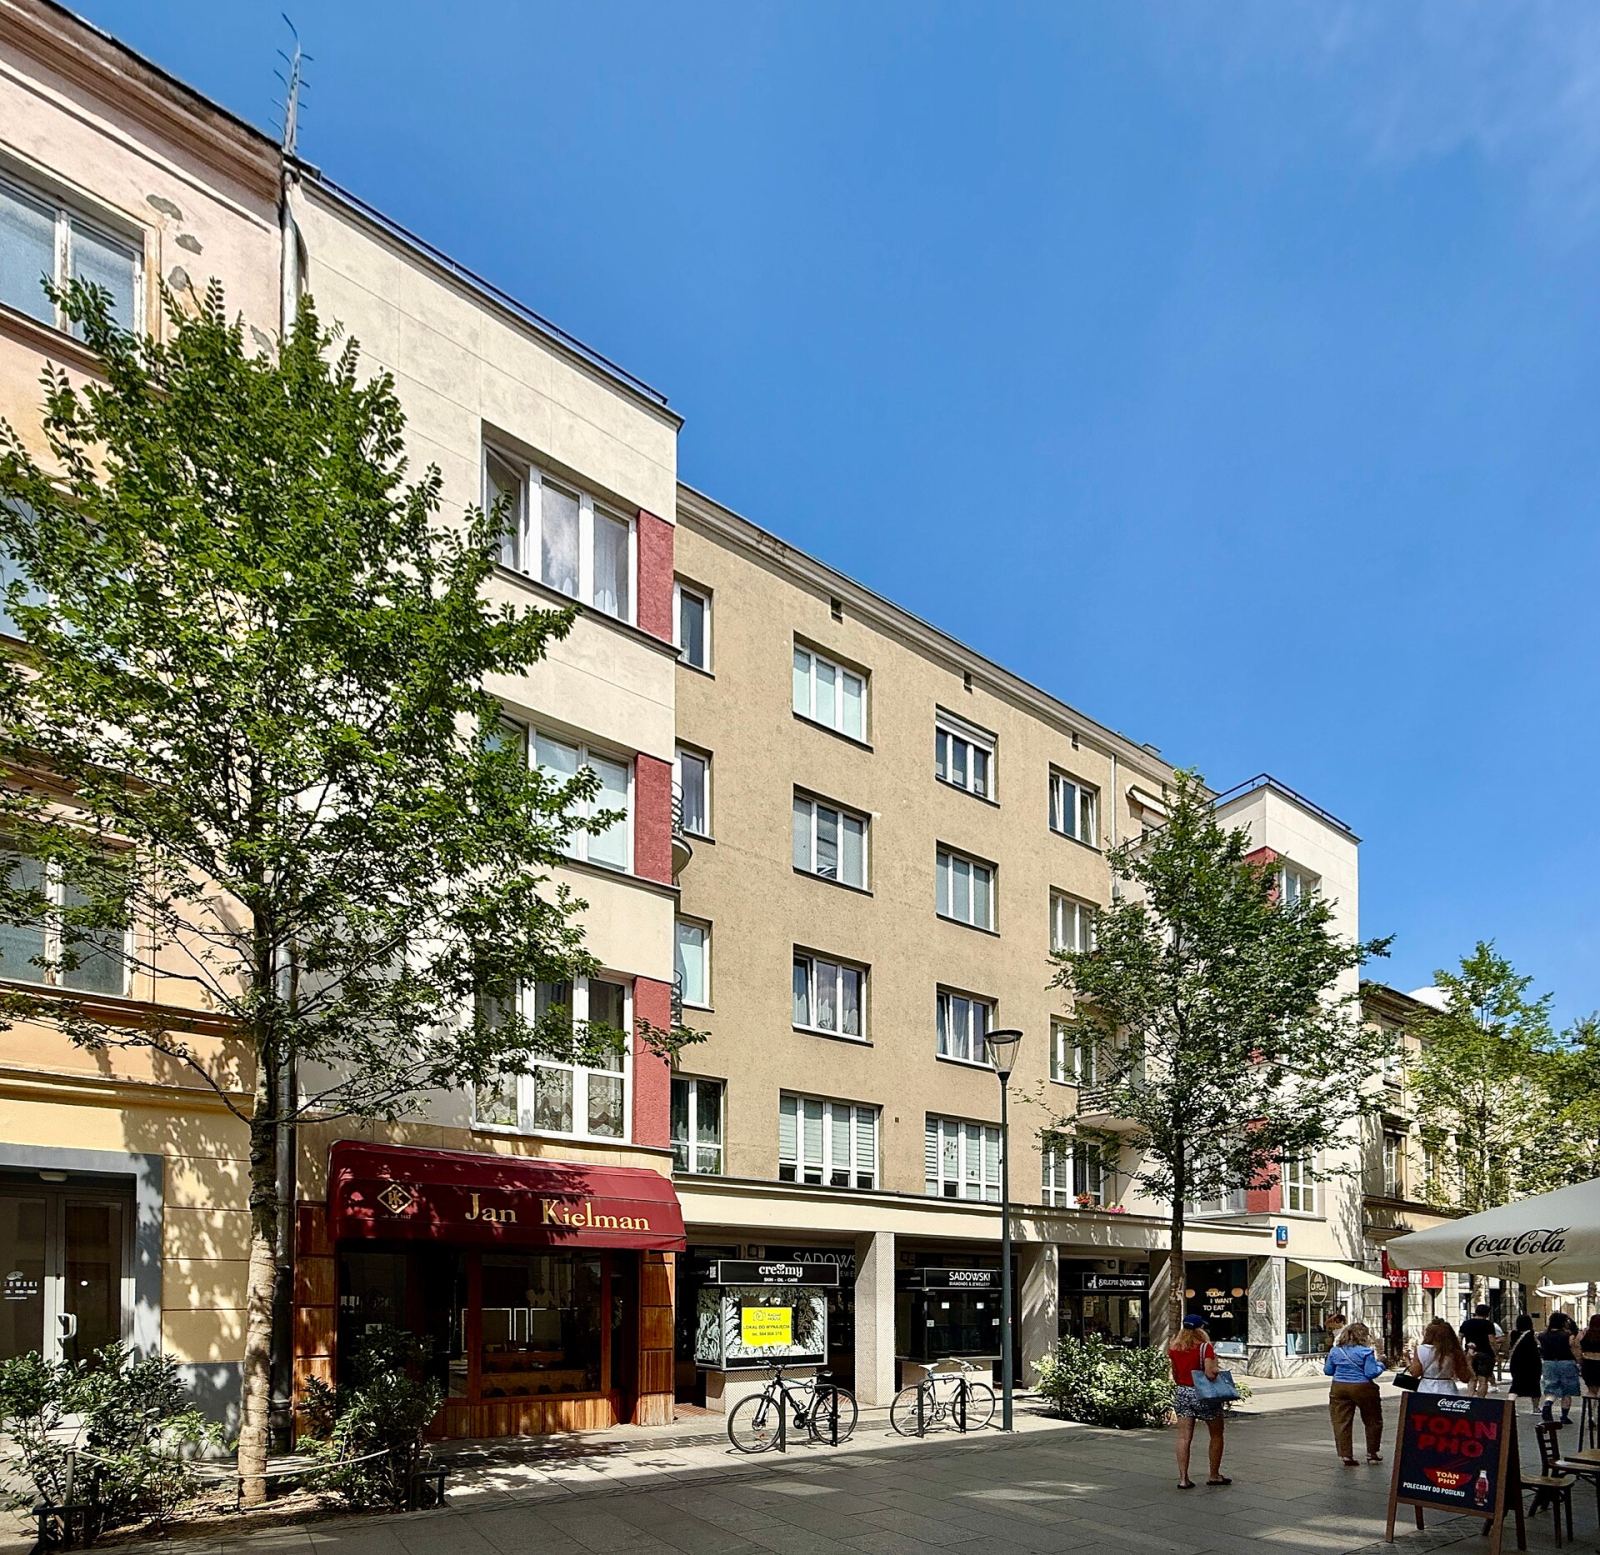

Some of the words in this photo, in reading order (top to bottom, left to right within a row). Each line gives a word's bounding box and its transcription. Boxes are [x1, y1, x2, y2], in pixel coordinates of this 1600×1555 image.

[465, 1193, 518, 1223] Jan
[539, 1198, 651, 1231] Kielman
[1465, 1226, 1571, 1259] Coca-Cola
[949, 1271, 991, 1281] SADOWSKI
[1206, 1290, 1225, 1298] TODAY
[1417, 1433, 1484, 1457] PHO
[1403, 1482, 1432, 1492] POLECAMY
